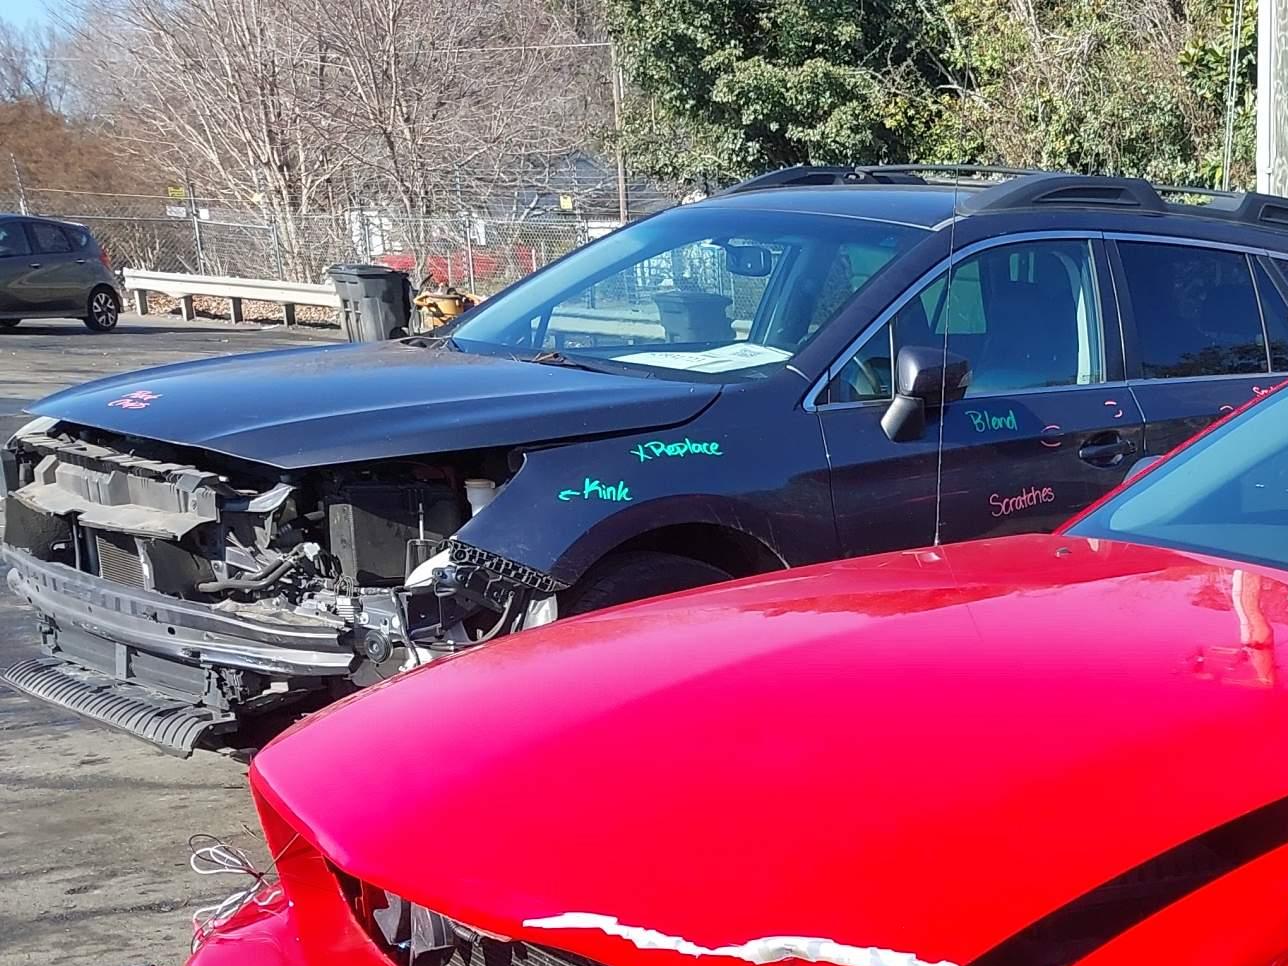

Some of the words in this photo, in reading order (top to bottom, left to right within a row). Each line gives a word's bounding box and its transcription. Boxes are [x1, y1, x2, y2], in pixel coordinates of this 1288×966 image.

[965, 410, 1018, 432] Blend
[644, 438, 723, 458] Replace
[583, 478, 633, 501] Kink
[989, 486, 1055, 517] Scratches
